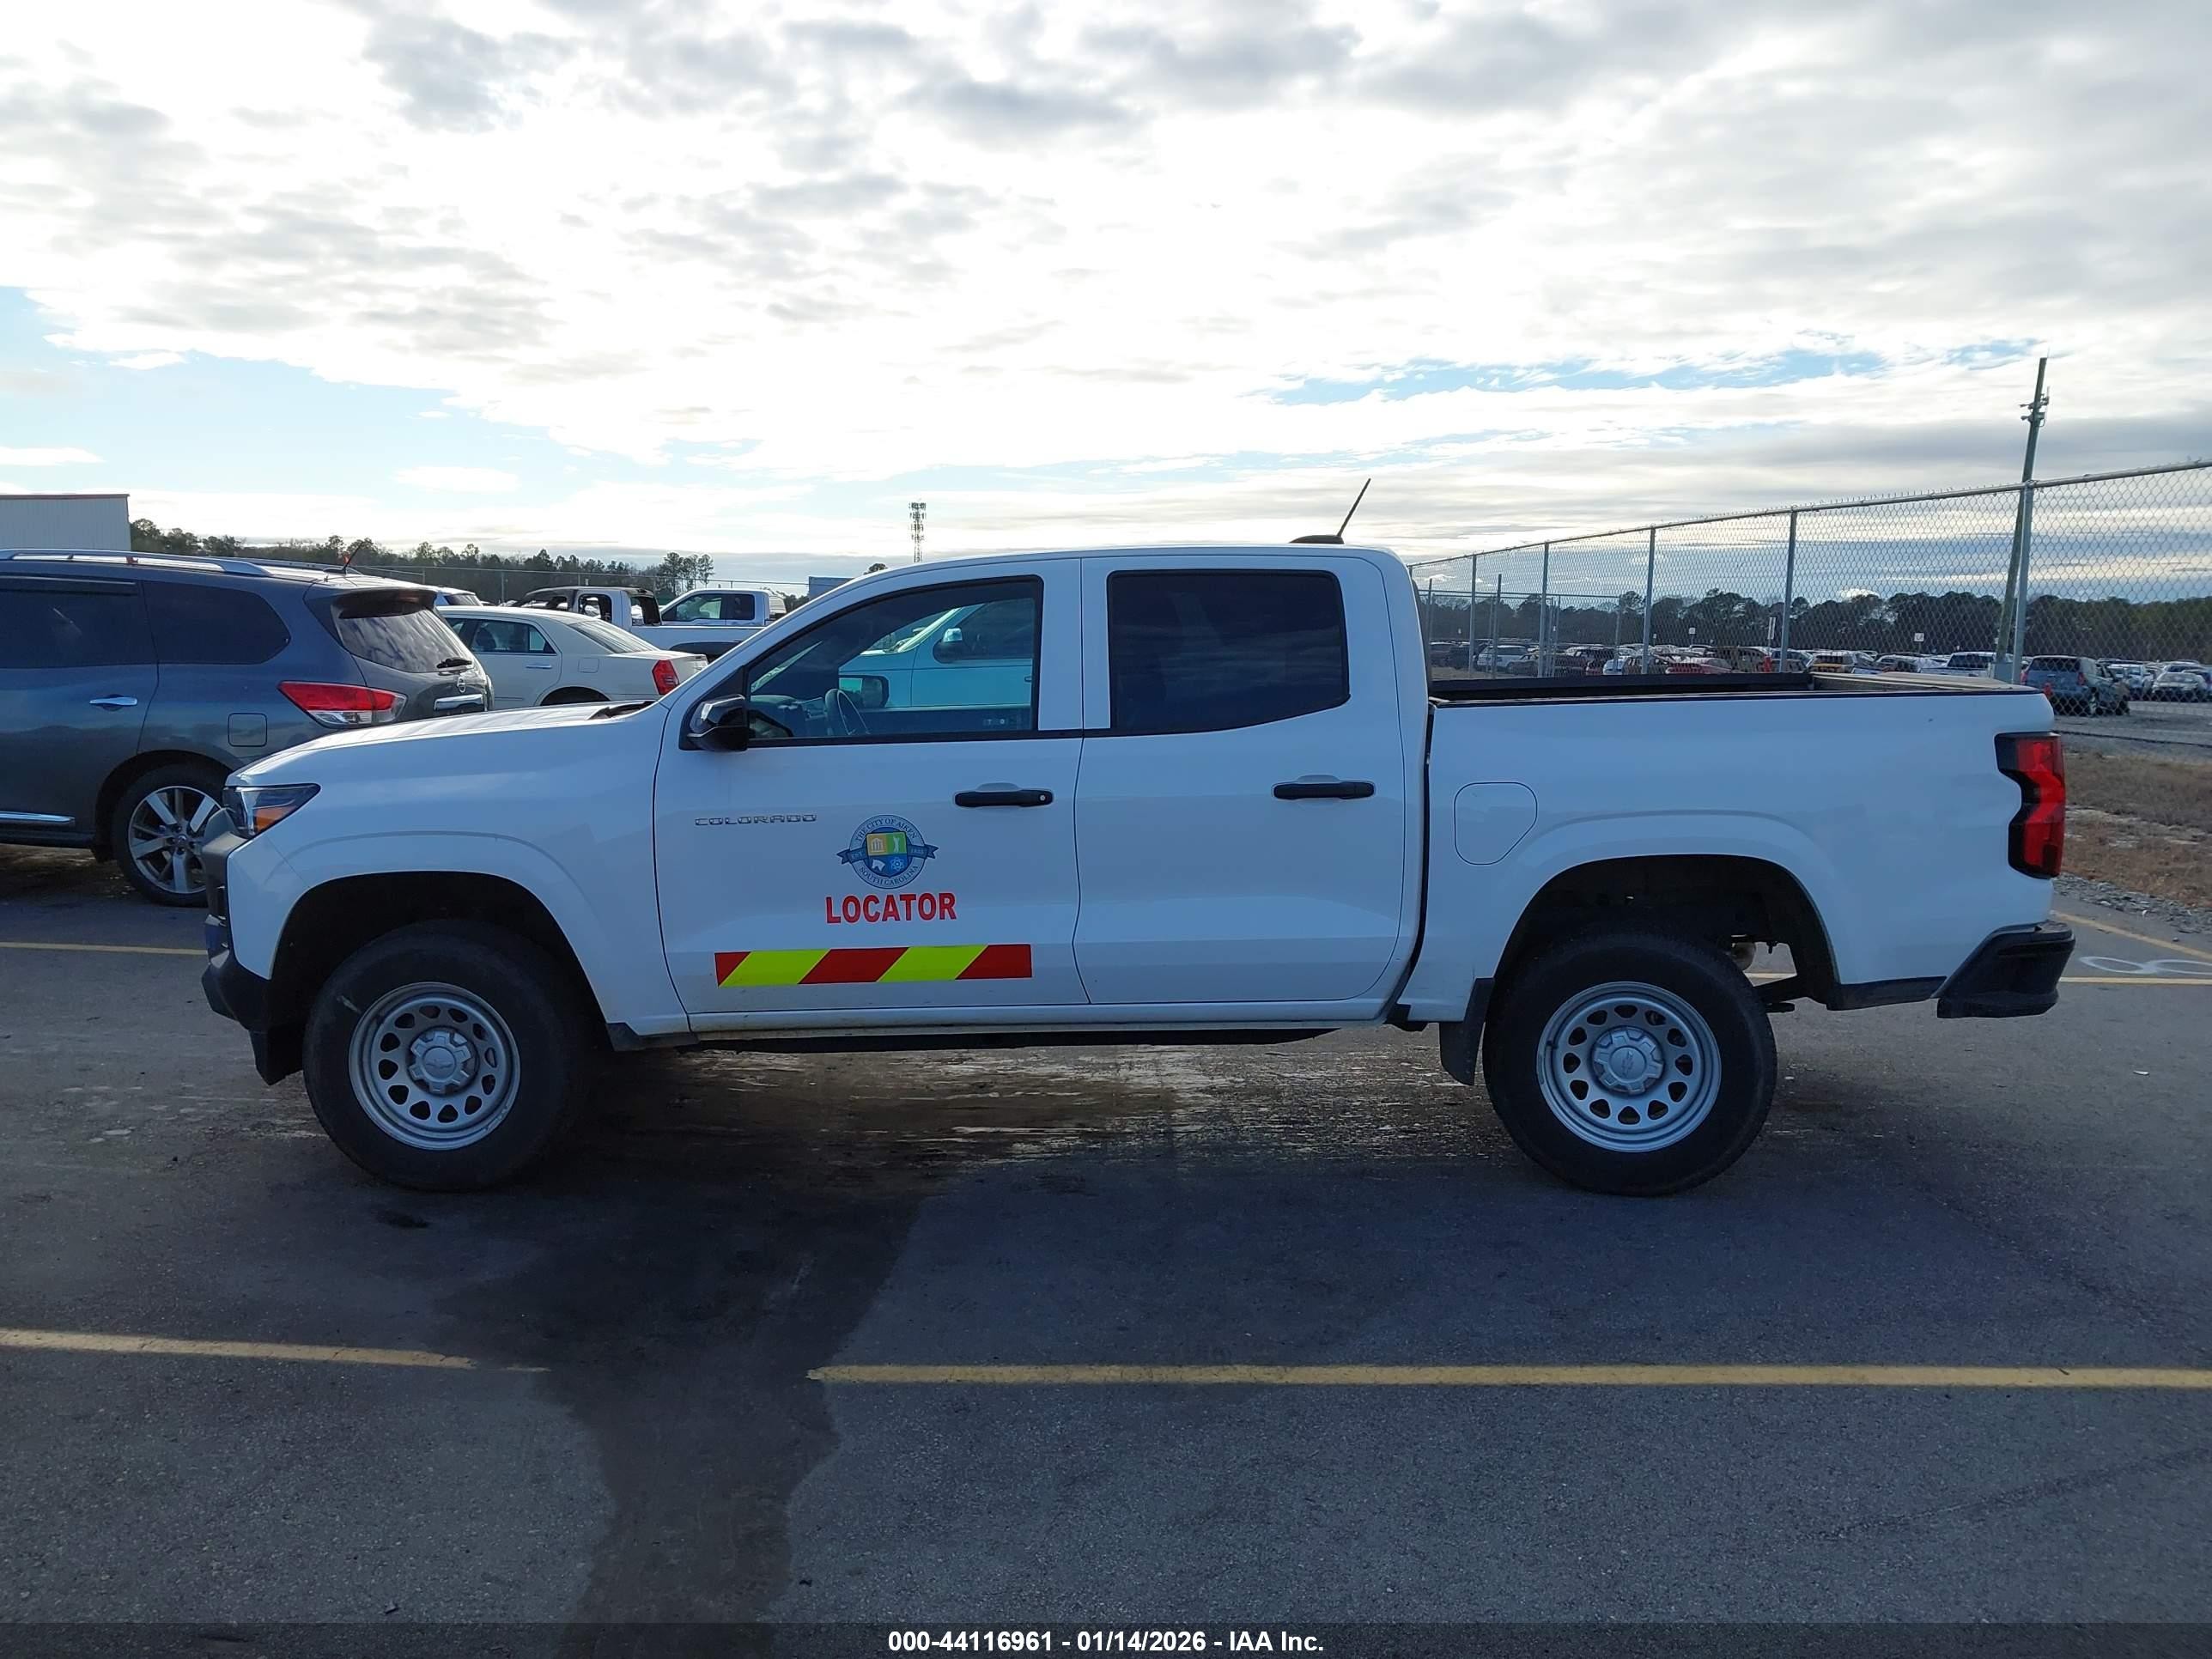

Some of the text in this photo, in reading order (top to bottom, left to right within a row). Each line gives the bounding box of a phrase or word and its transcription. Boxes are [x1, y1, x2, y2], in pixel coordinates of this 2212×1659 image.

[695, 814, 817, 826] COLORADO
[866, 818, 884, 830] CITY
[859, 866, 919, 885] SOUTH CAROLINA
[825, 892, 957, 924] LOCATOR
